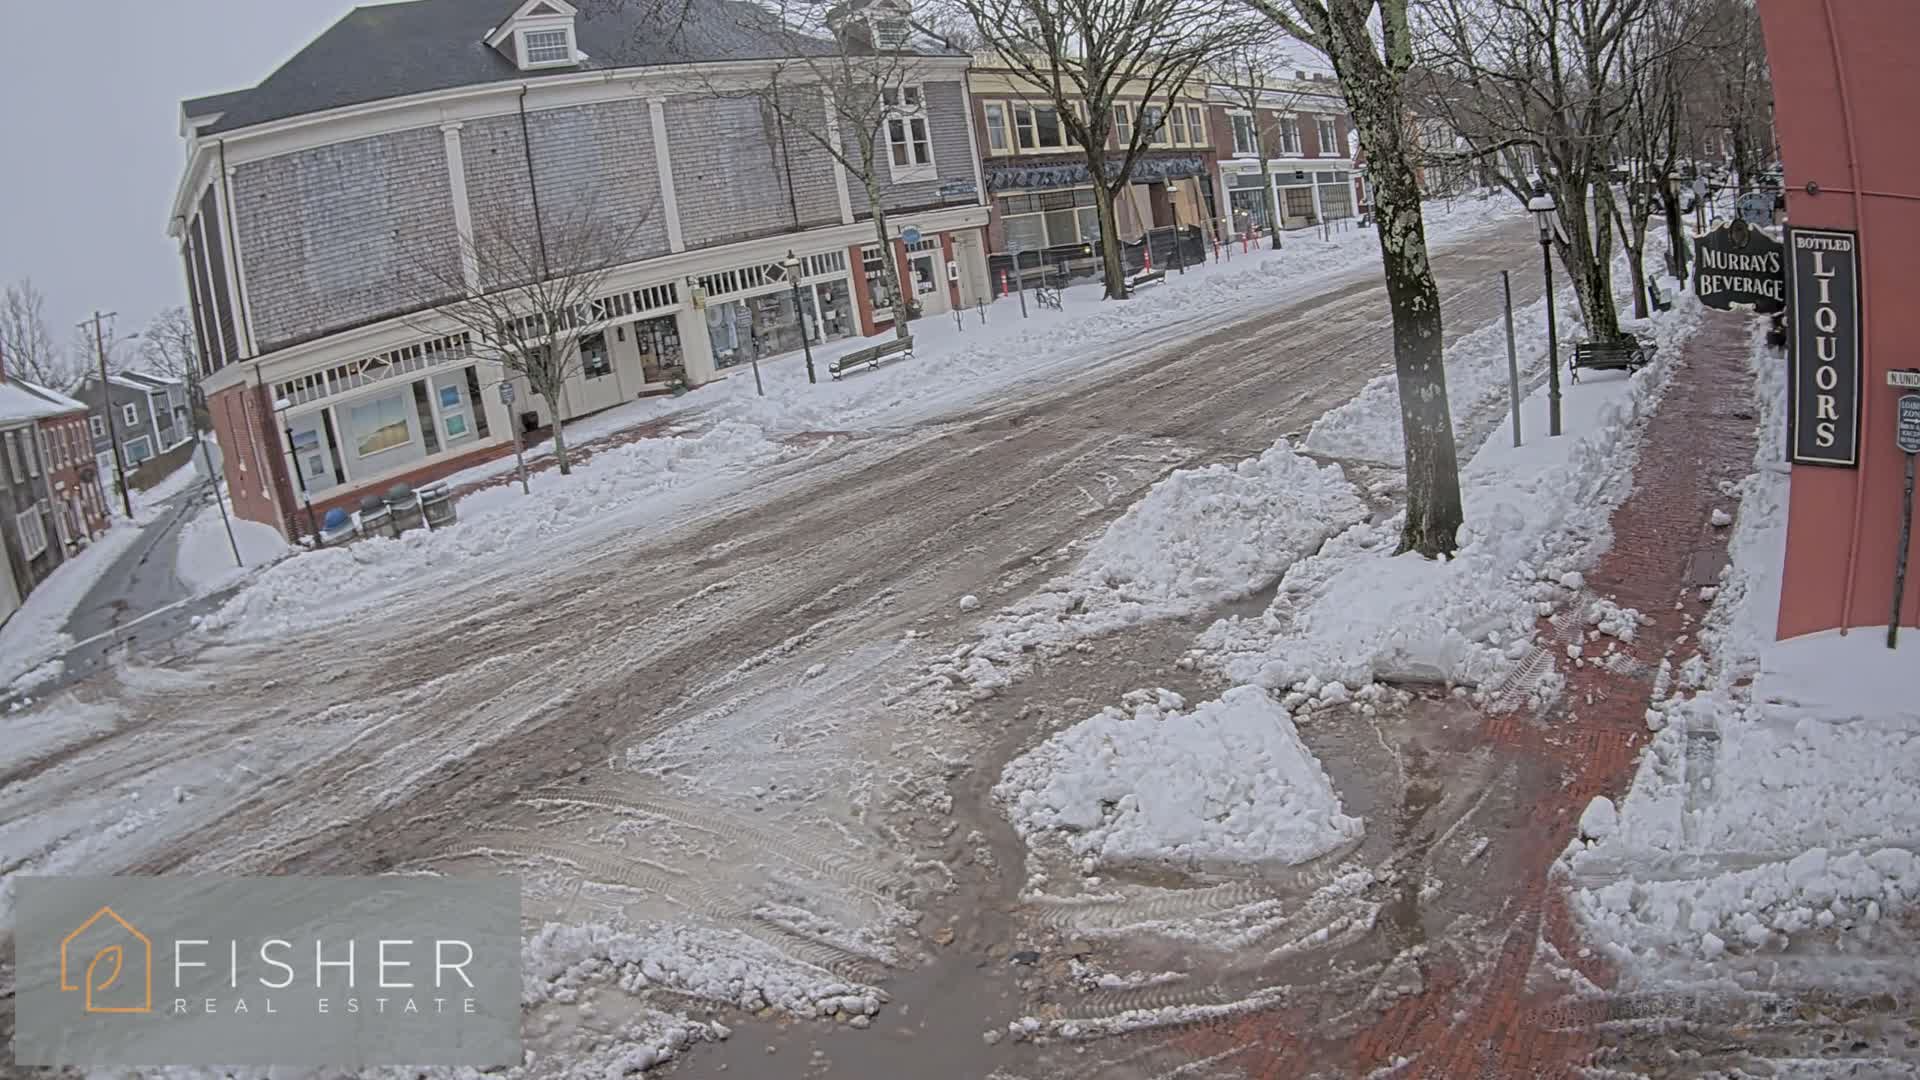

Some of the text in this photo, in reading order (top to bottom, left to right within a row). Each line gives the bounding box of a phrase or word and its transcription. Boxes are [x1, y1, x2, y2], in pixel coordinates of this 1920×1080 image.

[1796, 237, 1850, 251] BOTTLED
[1701, 246, 1780, 273] MURRAY'S
[1700, 275, 1784, 302] BEVERAGE
[1812, 251, 1839, 447] LIQUORS
